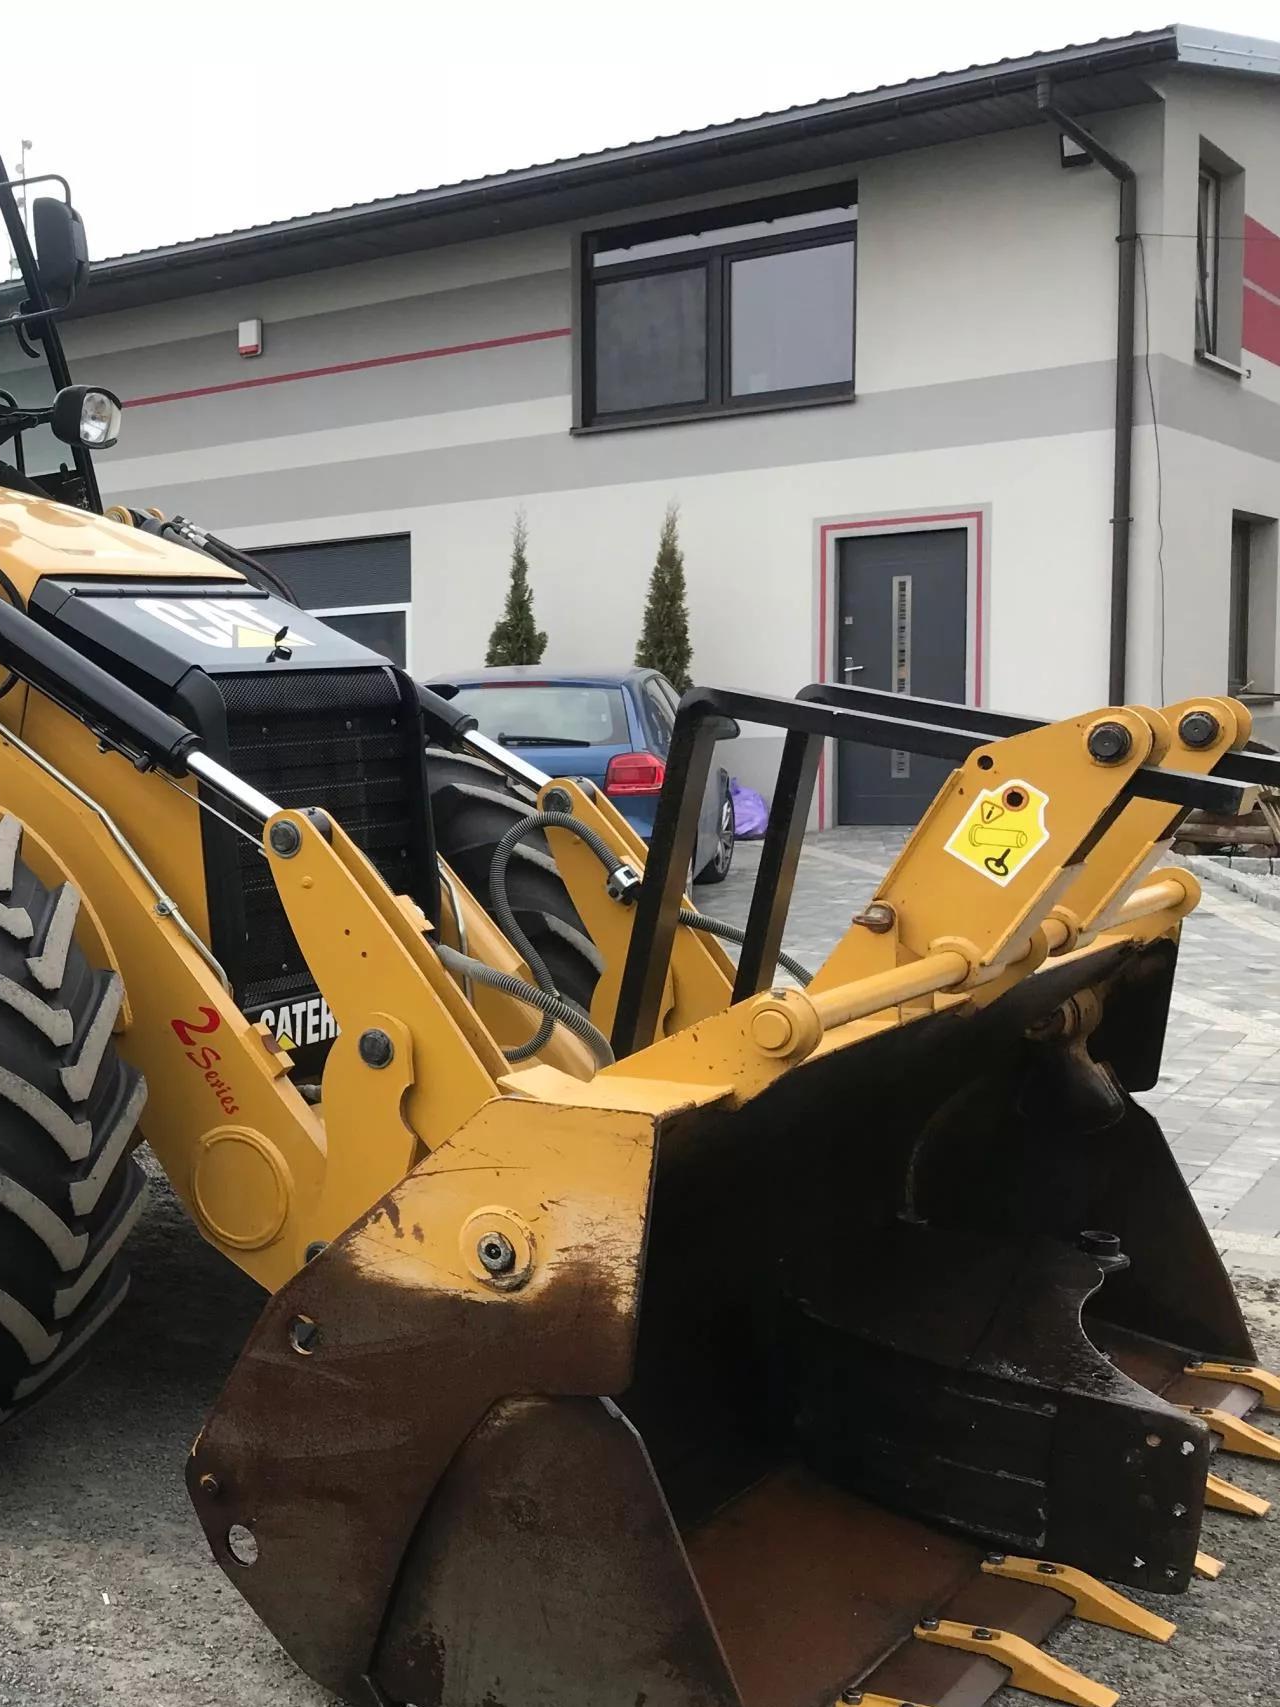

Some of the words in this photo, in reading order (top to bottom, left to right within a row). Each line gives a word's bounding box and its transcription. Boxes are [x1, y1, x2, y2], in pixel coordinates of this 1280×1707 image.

[134, 599, 317, 648] CAT
[171, 1006, 220, 1046] 2
[260, 997, 342, 1050] CATER
[186, 1046, 240, 1116] Series
